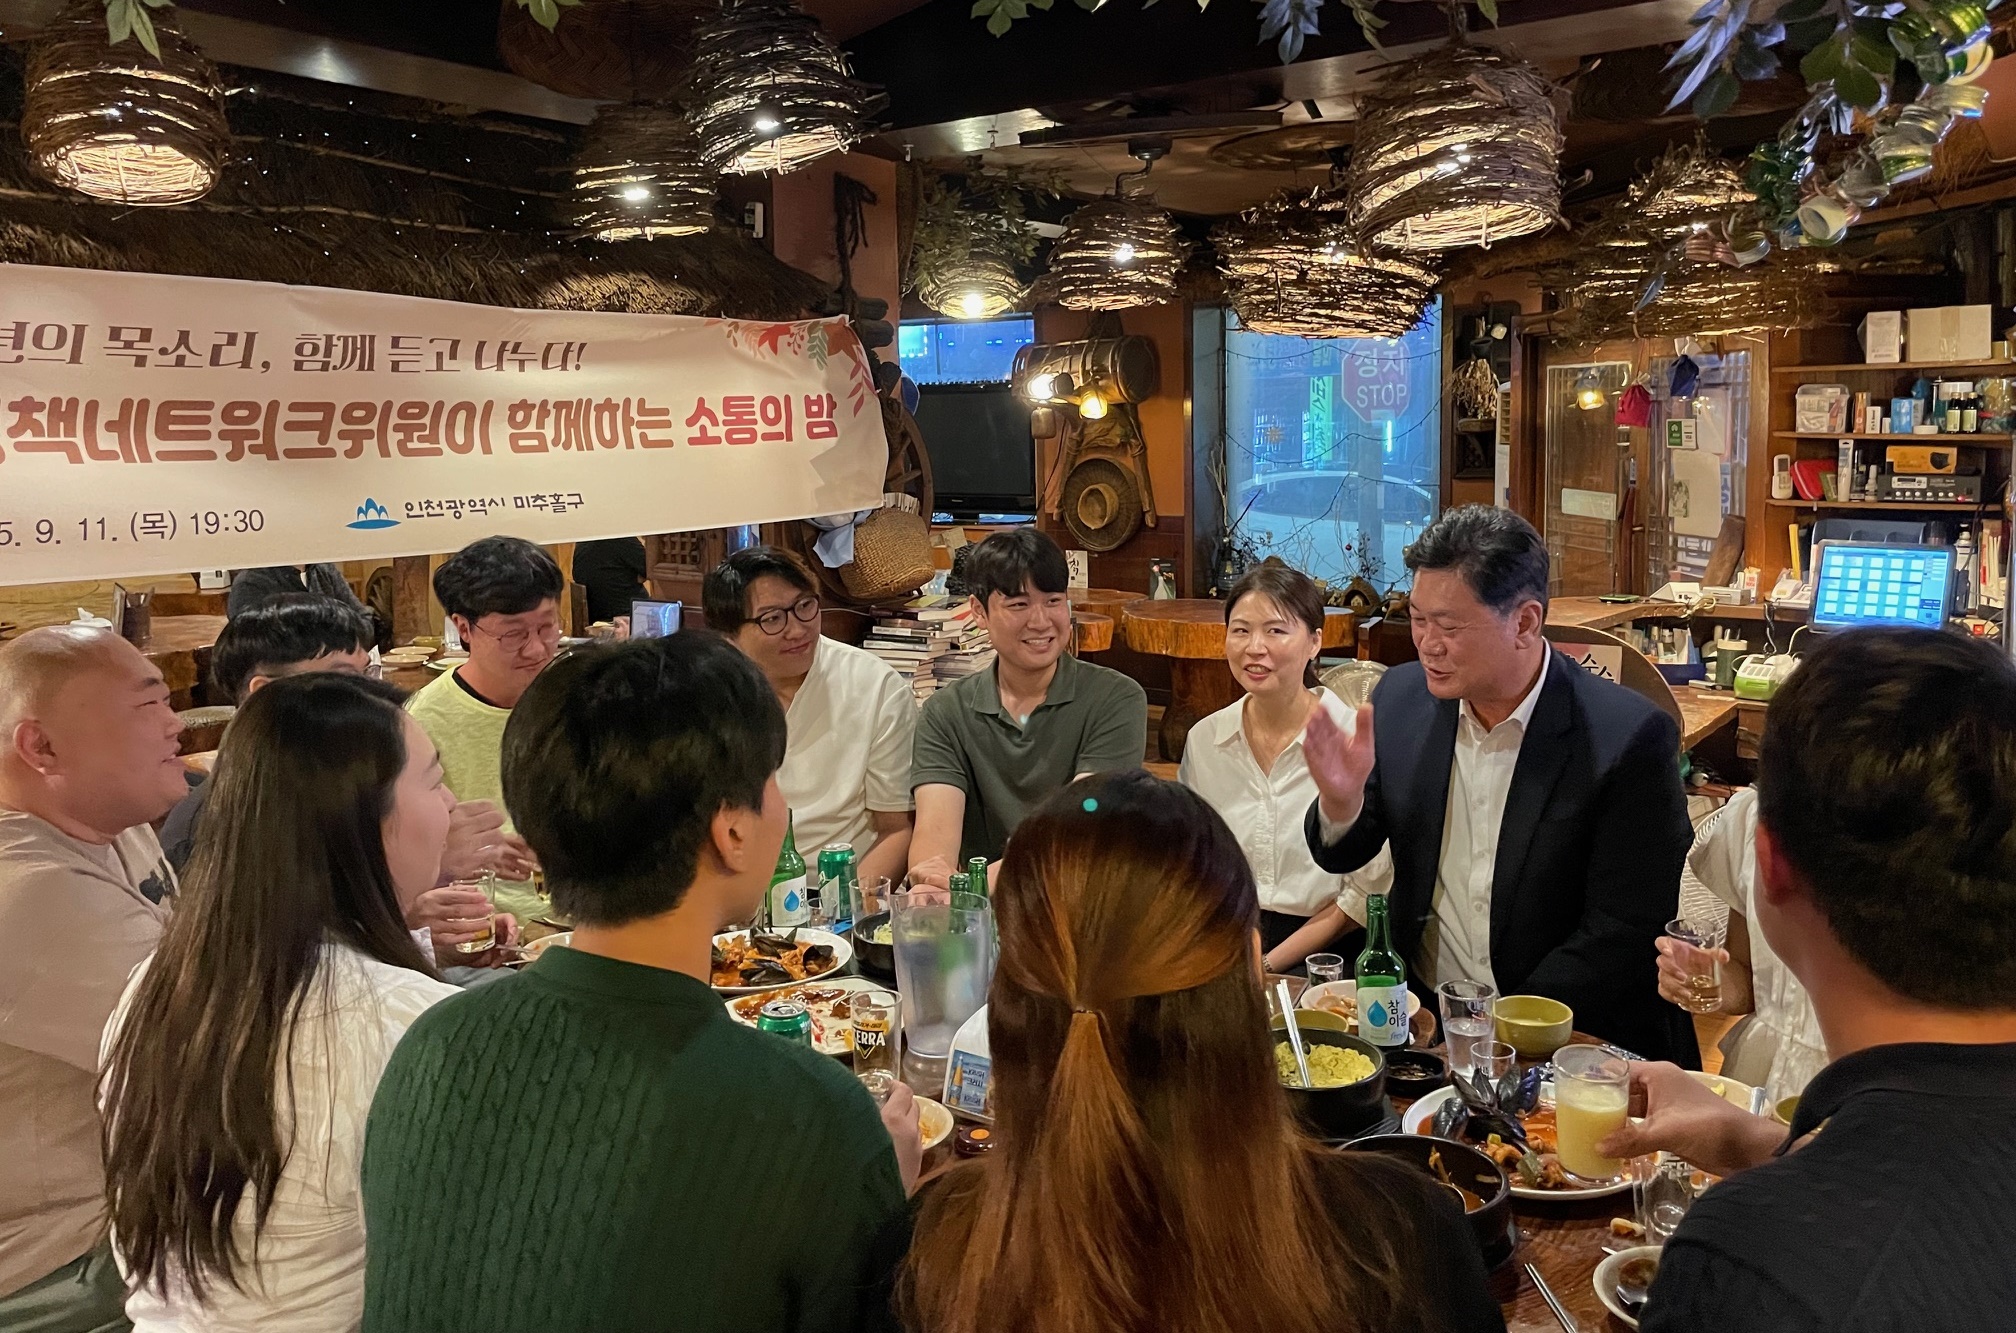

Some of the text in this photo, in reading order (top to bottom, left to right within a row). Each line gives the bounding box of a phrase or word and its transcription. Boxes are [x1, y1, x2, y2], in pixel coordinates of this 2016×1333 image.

[103, 326, 271, 373] 목소리,
[293, 333, 377, 372] 함께
[388, 336, 461, 373] 듣고
[475, 341, 588, 372] 나누다!
[1354, 346, 1404, 378] 정지
[1356, 384, 1407, 408] STOP
[0, 393, 838, 465] 책네트워크위원이 함께하는 소통의 밤
[404, 493, 585, 520] 인천광역시 미추홀구
[36, 519, 61, 545] 9.
[78, 516, 117, 541] 11.
[130, 510, 177, 541] (목)
[190, 509, 264, 535] 19:30
